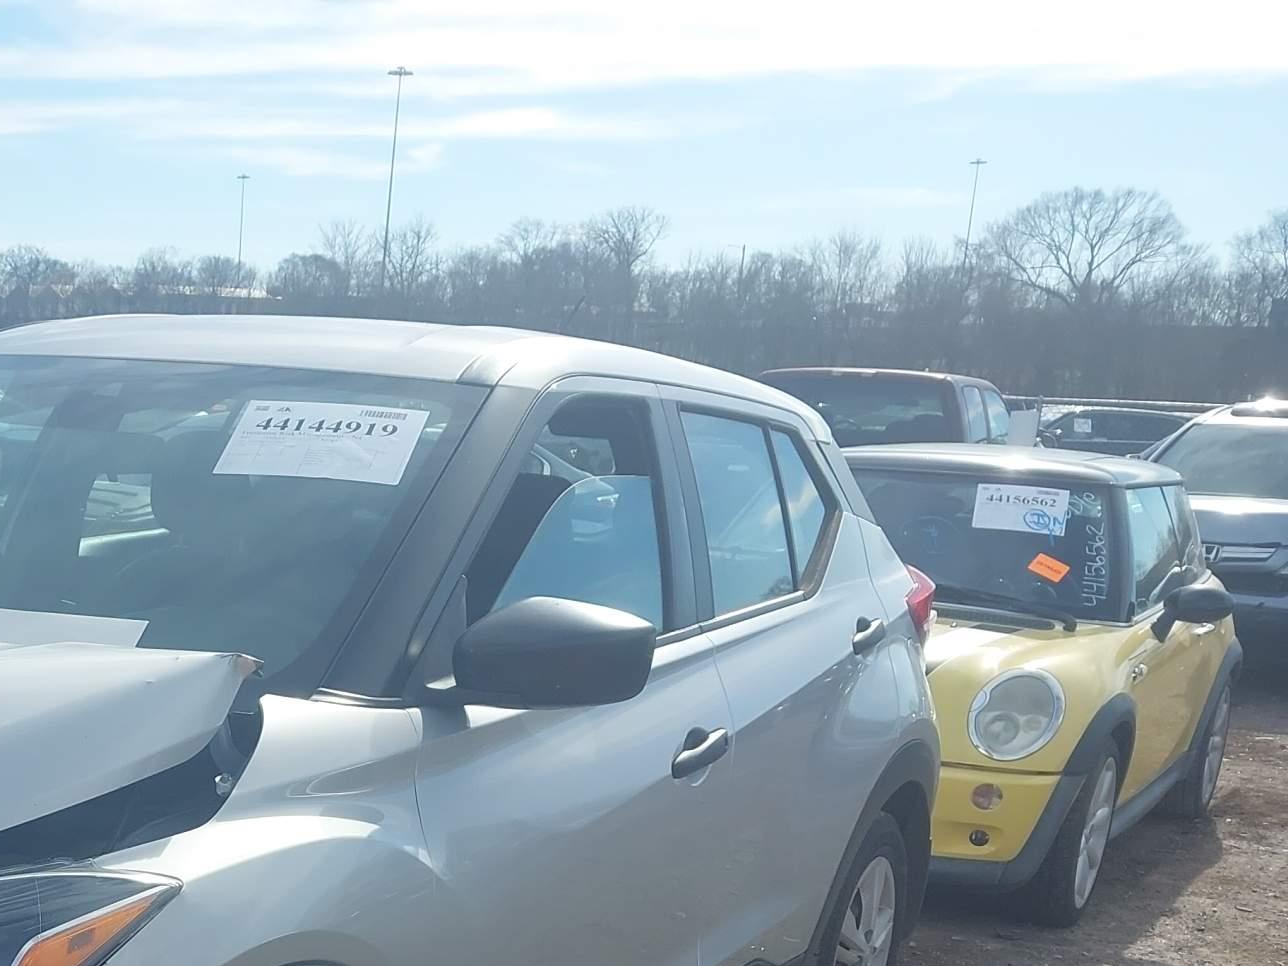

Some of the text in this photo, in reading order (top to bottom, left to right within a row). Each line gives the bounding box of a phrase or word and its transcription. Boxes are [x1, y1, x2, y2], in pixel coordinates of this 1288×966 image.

[256, 417, 398, 436] 44144919
[986, 494, 1056, 507] 44156562
[1081, 523, 1107, 607] 44156562
